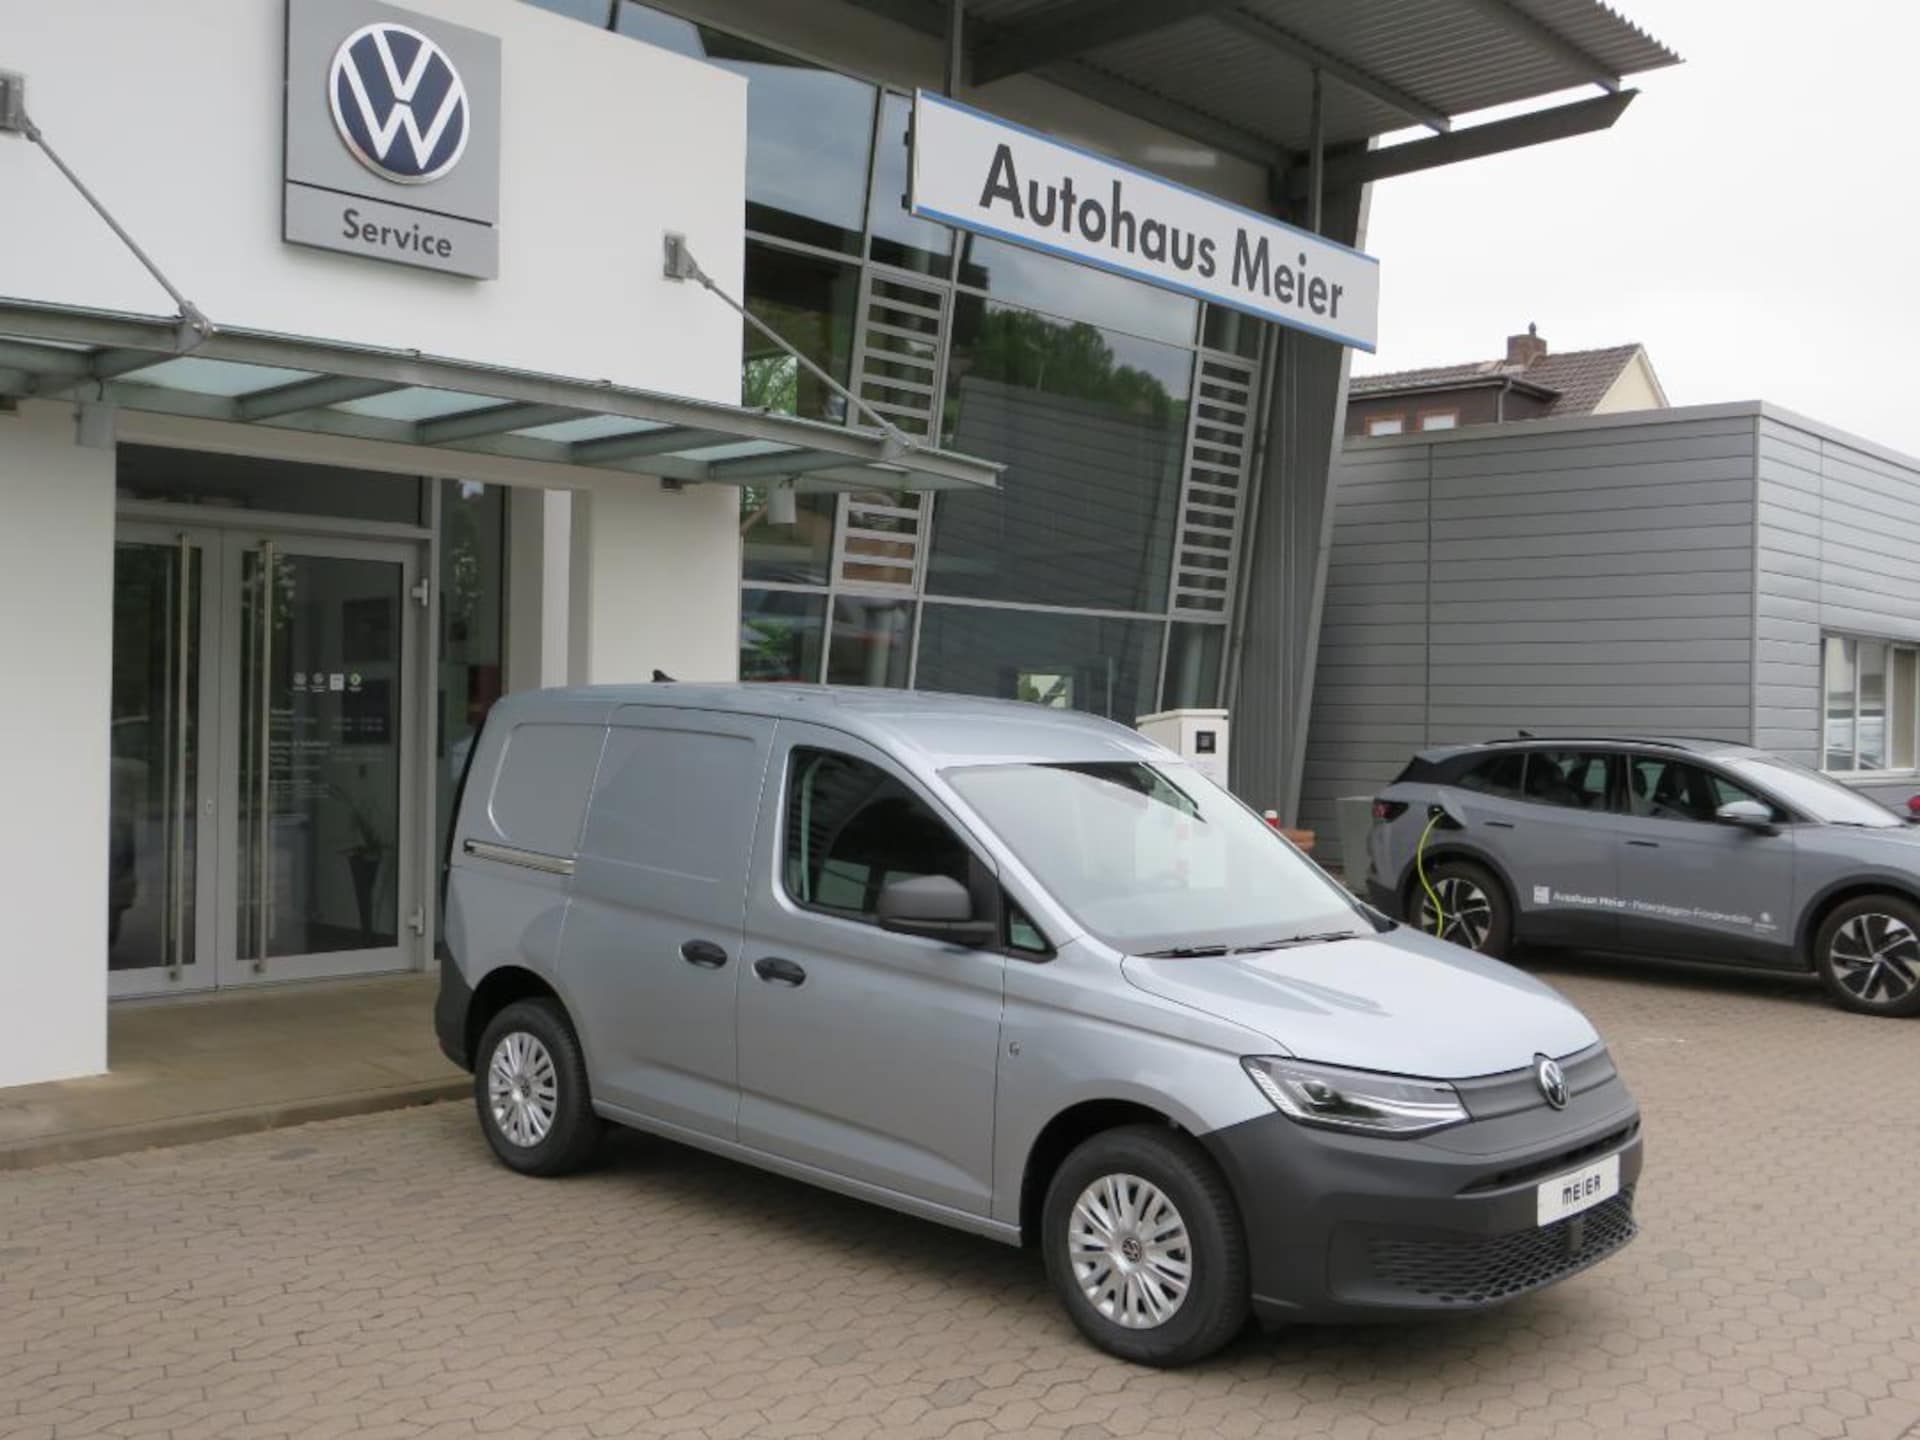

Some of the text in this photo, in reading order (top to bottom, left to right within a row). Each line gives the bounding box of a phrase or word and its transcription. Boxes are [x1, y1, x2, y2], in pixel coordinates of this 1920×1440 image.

[332, 25, 467, 178] VW
[342, 208, 452, 258] Service
[978, 143, 1343, 319] Autohaus Meier
